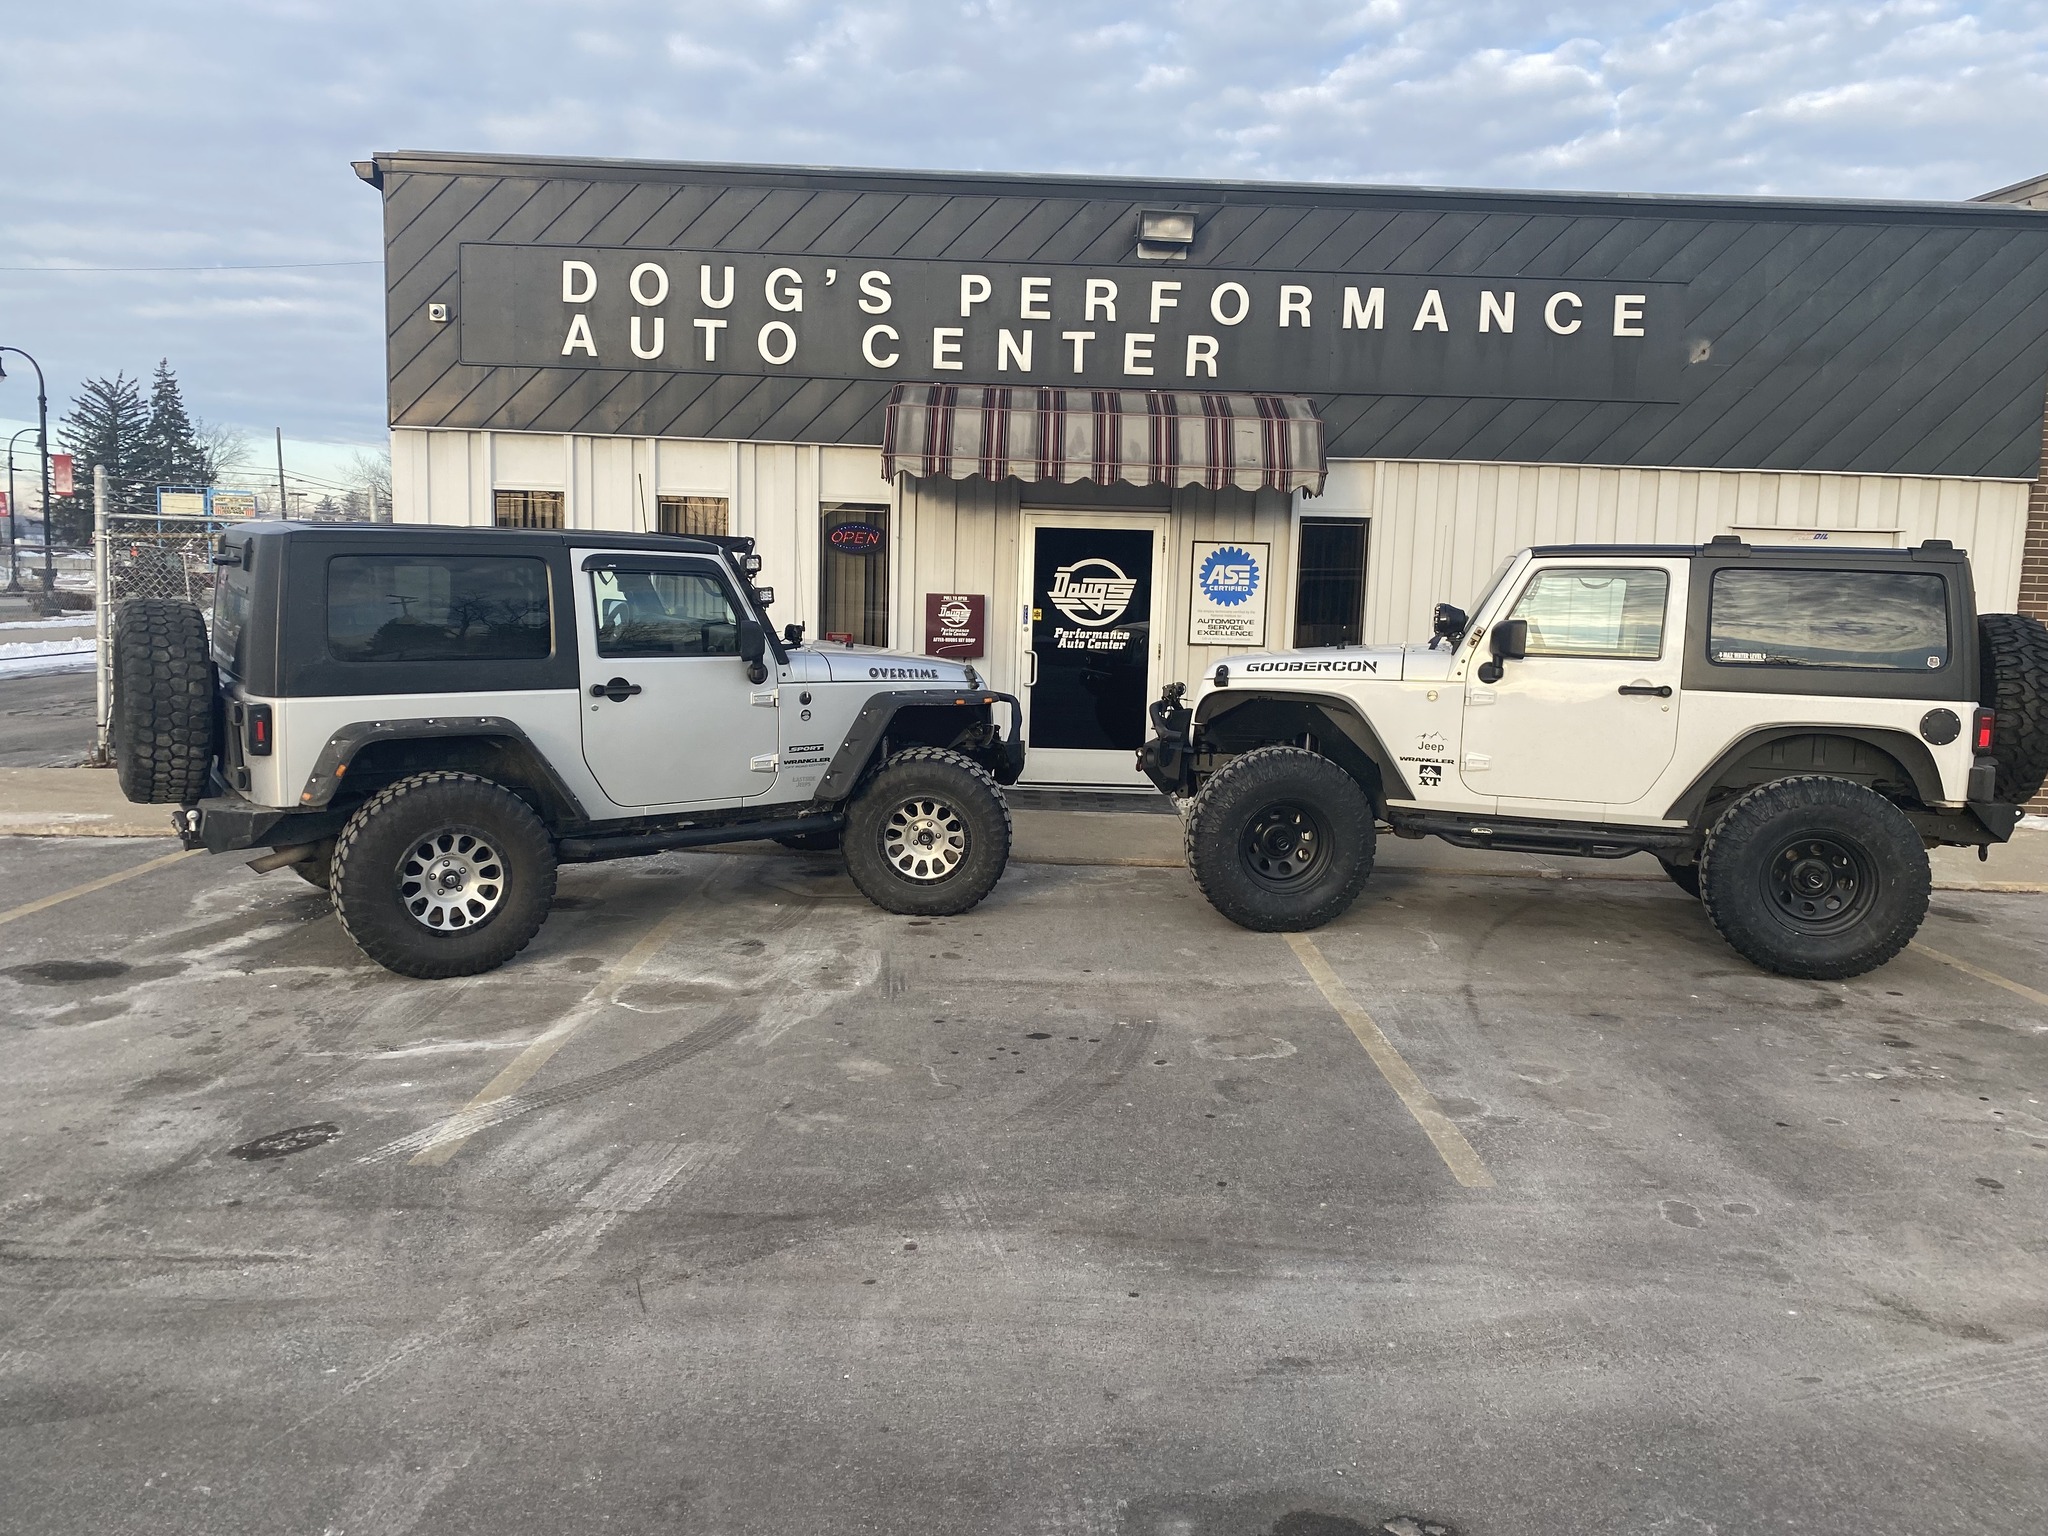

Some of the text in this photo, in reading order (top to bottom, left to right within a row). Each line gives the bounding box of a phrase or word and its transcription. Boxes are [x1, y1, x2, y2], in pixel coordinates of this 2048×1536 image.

[563, 261, 1645, 336] DOUG'S PERFORMANCE
[562, 314, 1218, 377] AUTO CENTER
[831, 530, 880, 545] OPEN
[1206, 564, 1250, 585] ASE
[1054, 627, 1130, 640] Performance
[1057, 638, 1126, 649] Auto Center
[869, 667, 939, 679] OVERTIME
[1246, 660, 1378, 674] GOOBERCON
[1418, 741, 1444, 753] Jeep
[783, 757, 830, 765] WRANGLER
[1399, 756, 1454, 764] WRANGLER
[1418, 776, 1441, 786] XT
